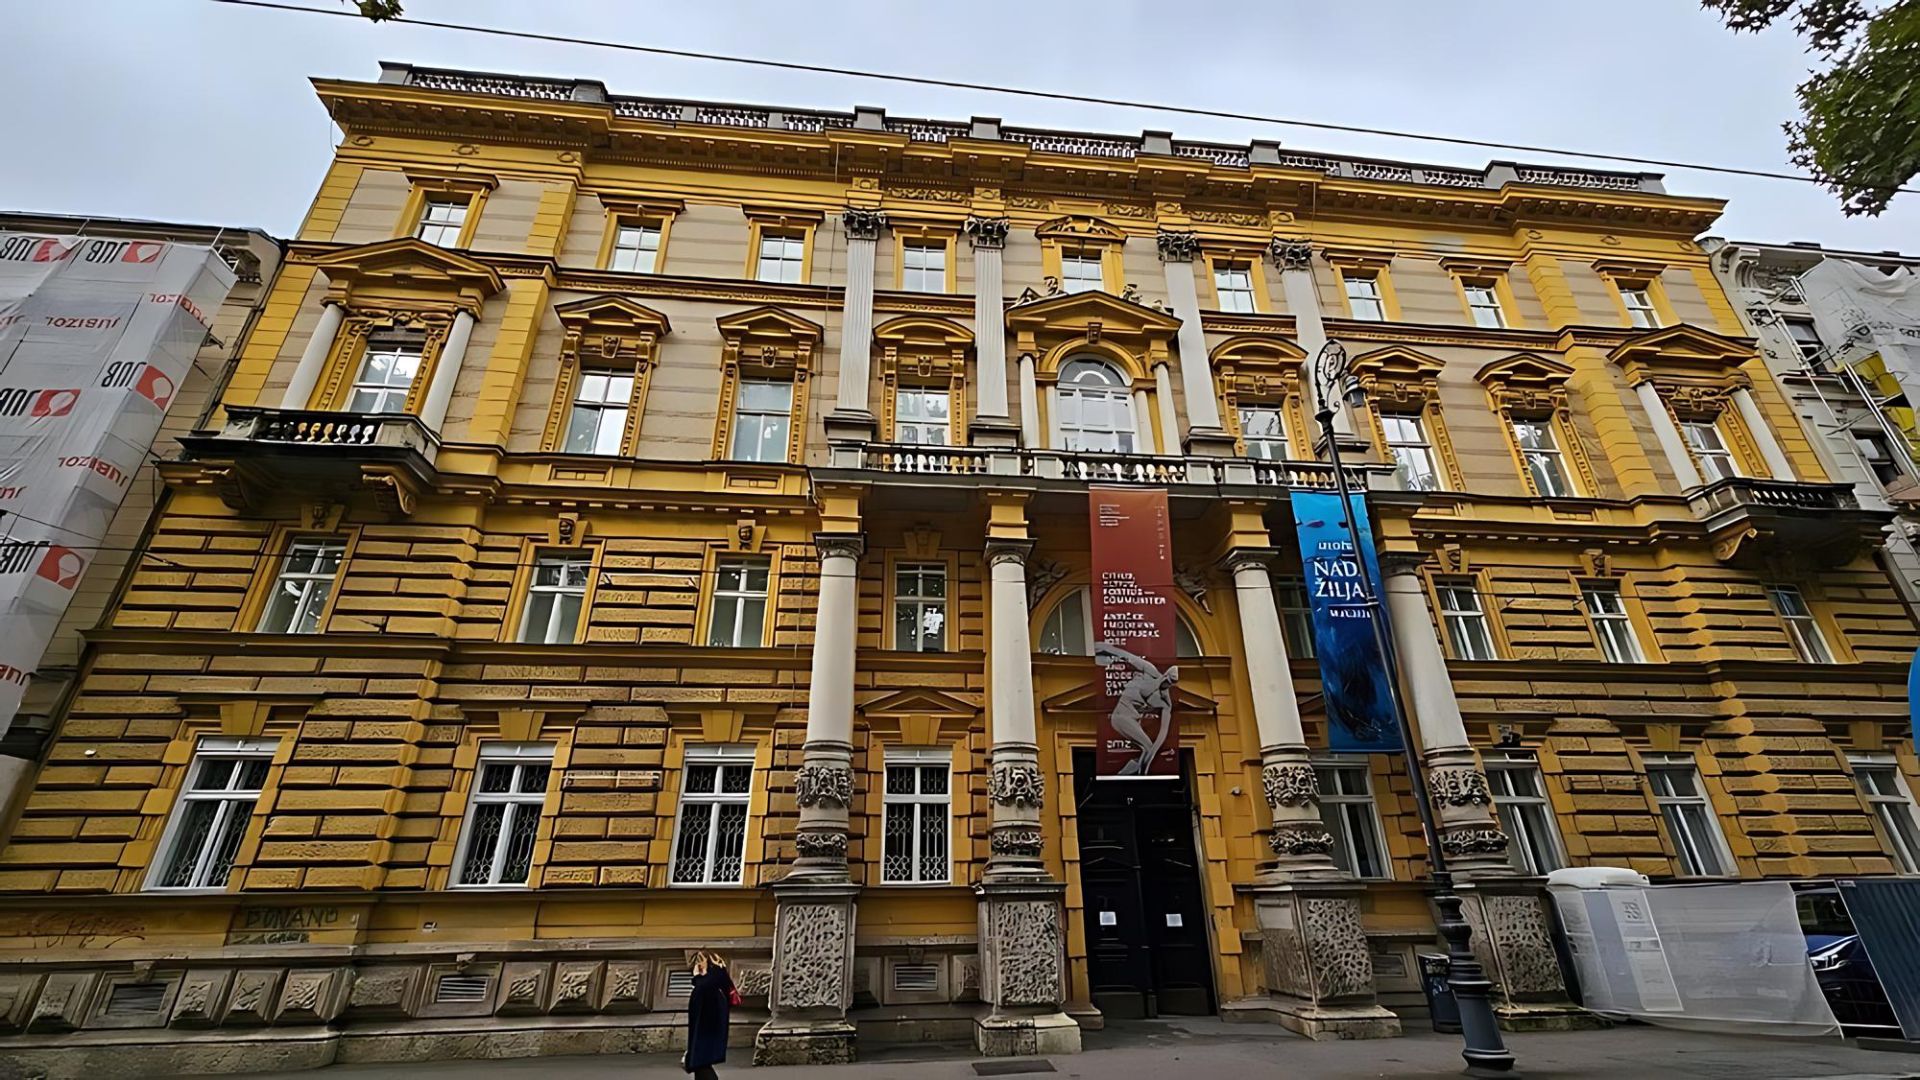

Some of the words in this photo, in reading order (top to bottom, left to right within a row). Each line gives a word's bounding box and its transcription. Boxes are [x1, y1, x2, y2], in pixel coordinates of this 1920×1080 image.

[0, 236, 40, 261] JUB
[86, 240, 130, 264] JUB
[46, 316, 121, 328] JUBIZOL
[101, 361, 148, 387] JUB
[58, 456, 129, 487] JUBIZOL
[1313, 560, 1361, 577] NAD
[1314, 577, 1371, 600] ŽILJA
